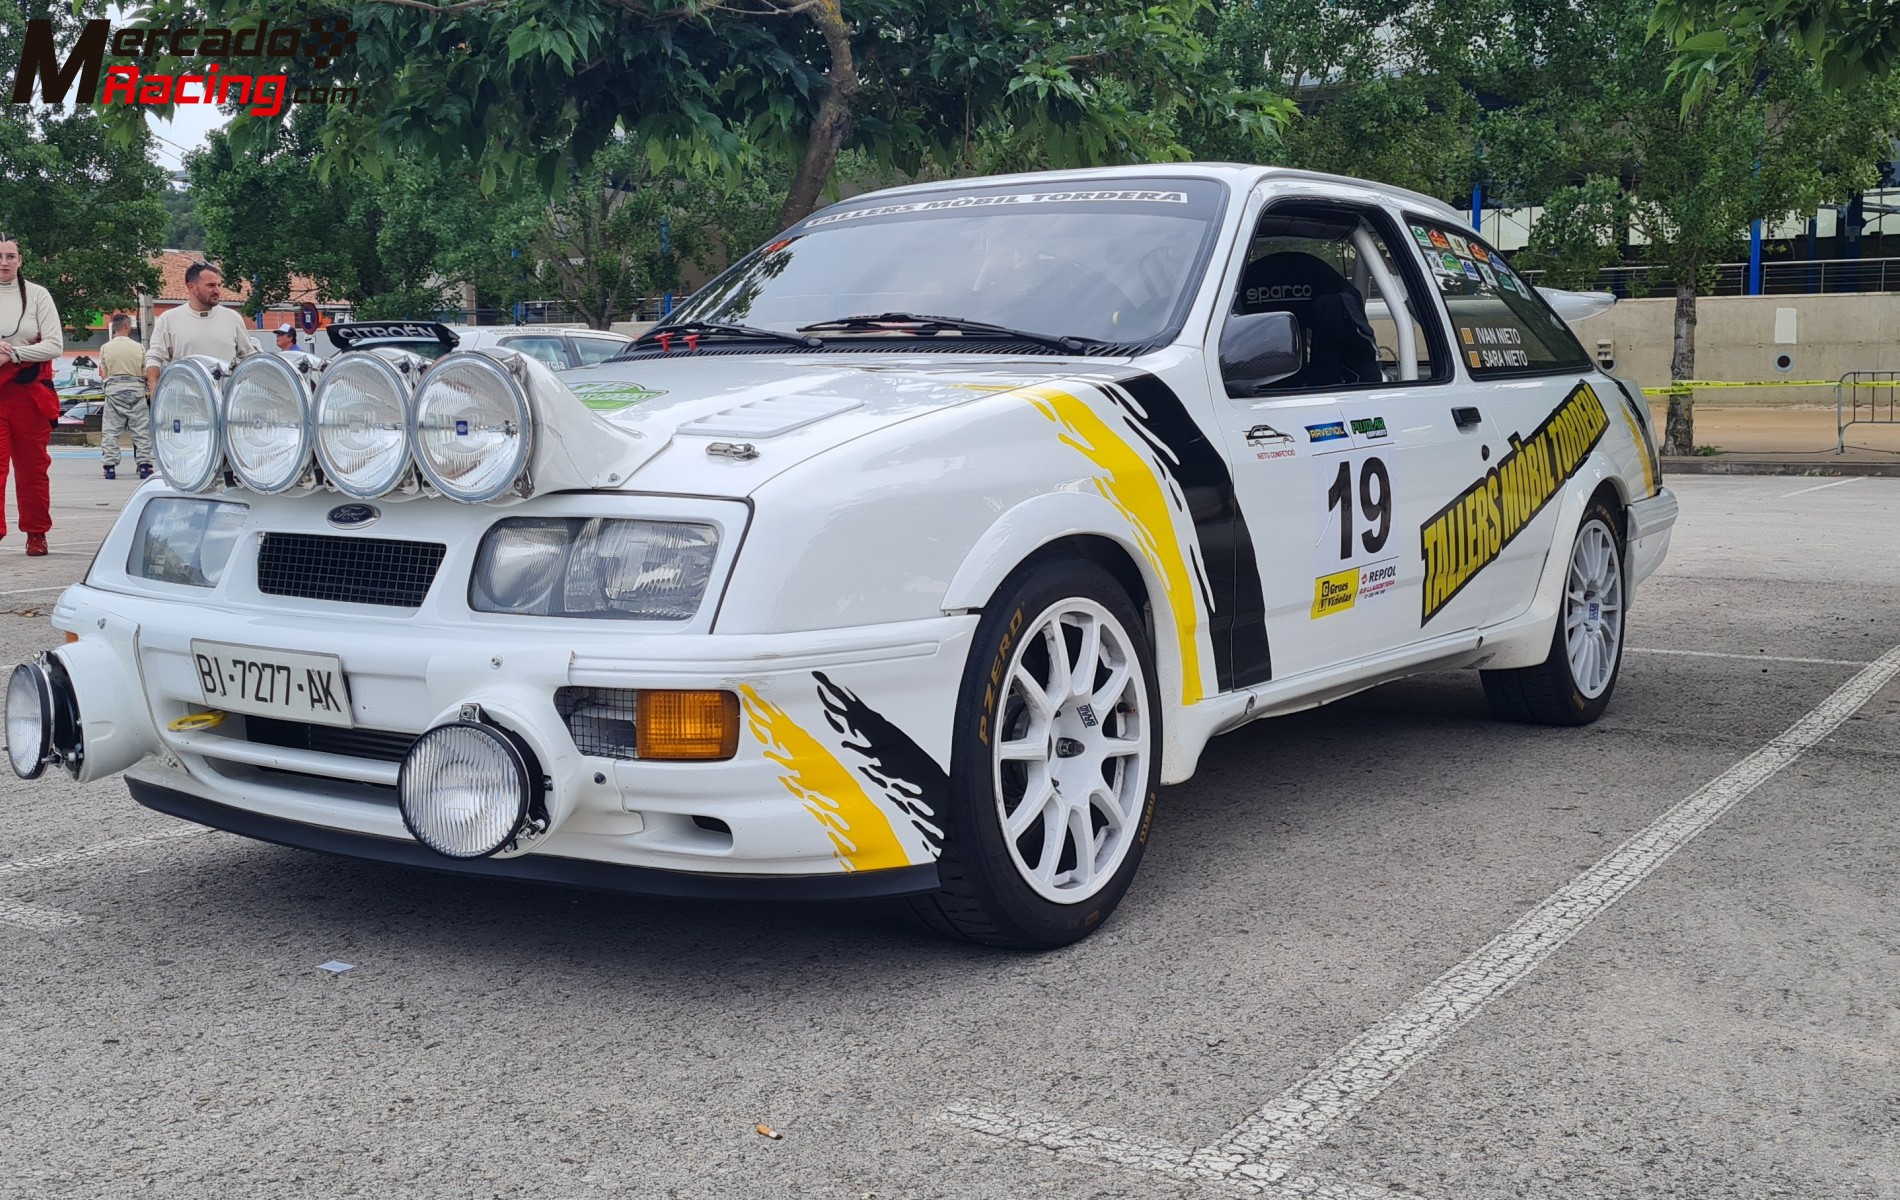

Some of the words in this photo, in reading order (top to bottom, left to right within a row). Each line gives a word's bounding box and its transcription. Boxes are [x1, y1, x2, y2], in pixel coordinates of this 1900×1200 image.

[810, 203, 918, 226] TALLERS
[1032, 192, 1182, 202] TORDERA
[1246, 284, 1312, 304] sparco
[338, 324, 438, 339] CITROËN
[1475, 327, 1498, 344] IVAN
[1495, 327, 1521, 344] NIETO
[1482, 350, 1505, 367] SARA
[1502, 350, 1528, 367] NIETO
[1310, 426, 1345, 439] RAVENOL
[1328, 456, 1392, 560] 19
[1424, 475, 1501, 617] TALLERS
[1547, 383, 1607, 482] TORDERA
[1369, 565, 1396, 583] REPSOL
[1079, 704, 1097, 727] BRAID
